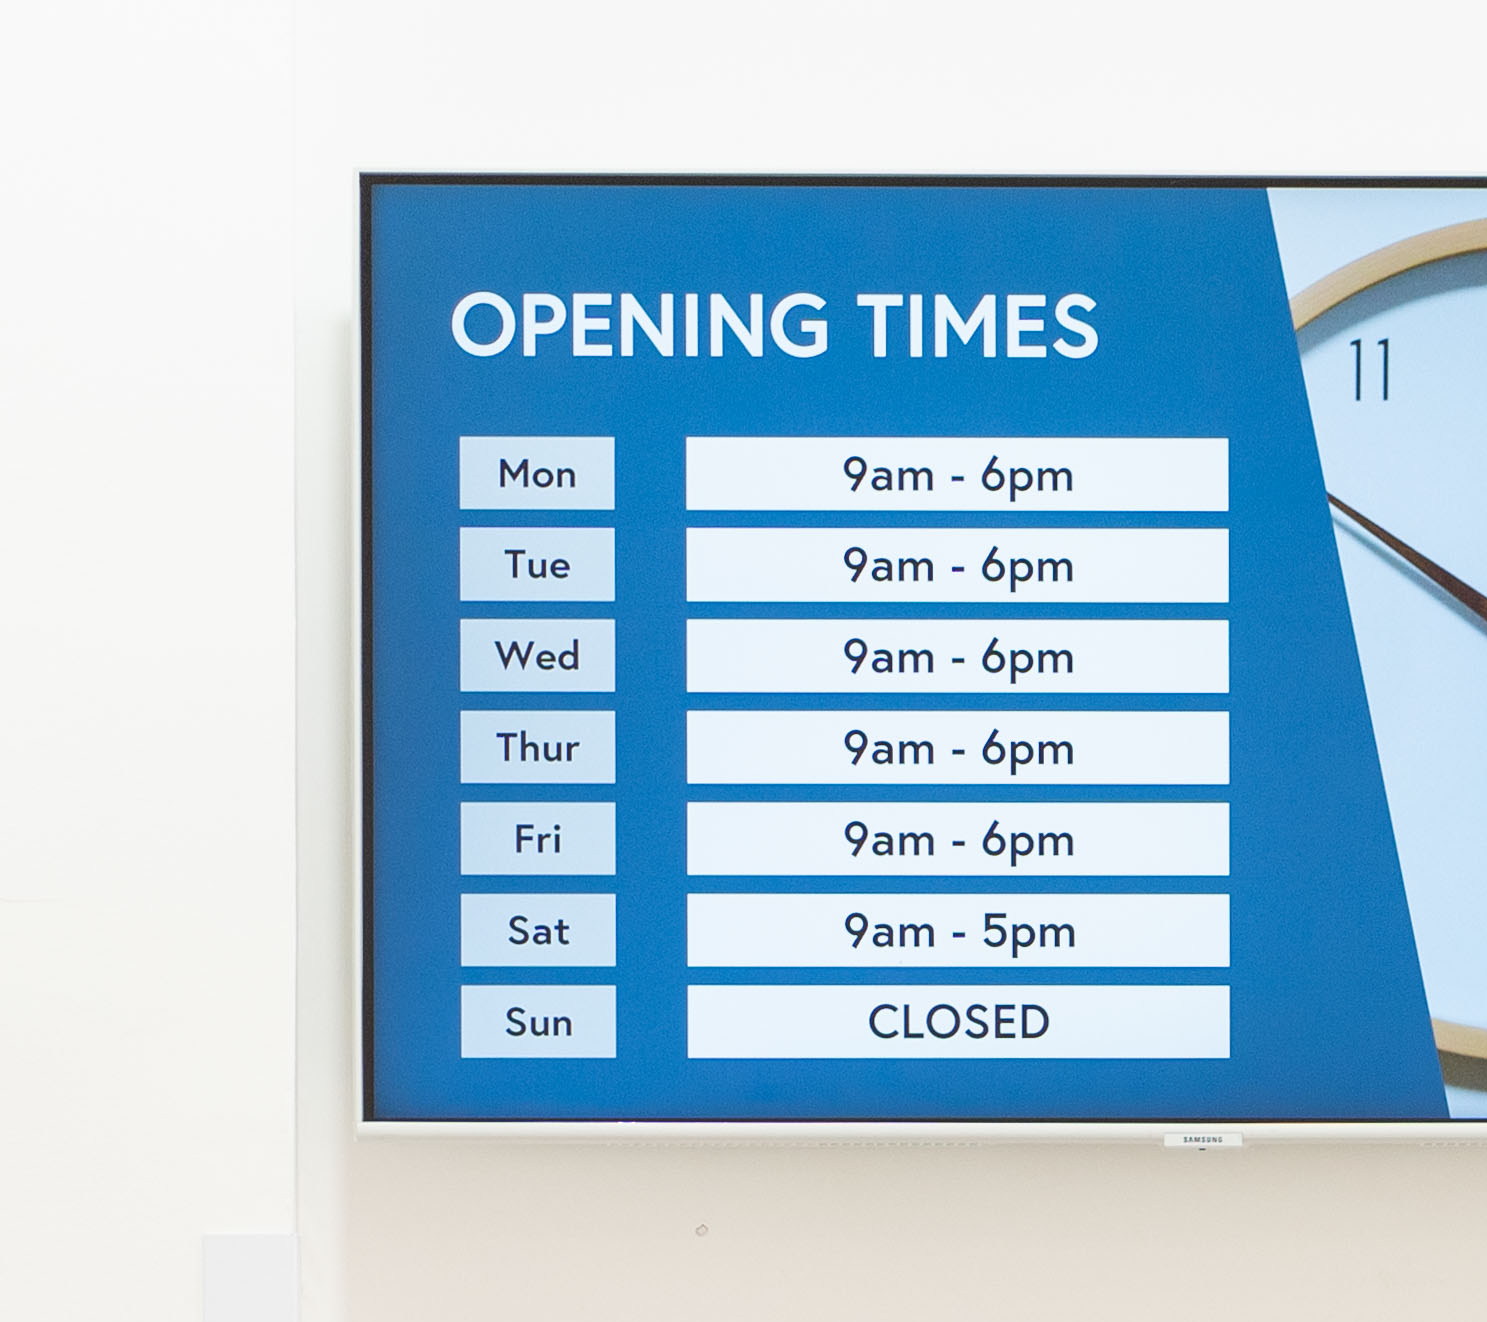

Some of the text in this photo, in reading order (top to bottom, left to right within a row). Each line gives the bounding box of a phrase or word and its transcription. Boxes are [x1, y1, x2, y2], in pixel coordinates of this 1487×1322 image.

[452, 292, 1098, 358] OPENING TIMES
[1350, 339, 1388, 401] 11
[500, 459, 575, 487] Mon
[844, 456, 933, 492] 9am
[982, 455, 1072, 502] 6pm
[505, 550, 570, 578] Tue
[844, 547, 933, 582] 9am
[982, 546, 1072, 592] 6pm
[495, 639, 578, 670] Wed
[844, 638, 933, 674] 9am
[982, 637, 1072, 684] 6pm
[496, 730, 580, 761] Thur
[845, 730, 933, 765] 9am
[983, 729, 1073, 775] 6pm
[516, 824, 560, 853] Fri
[845, 821, 934, 857] 9am
[983, 820, 1073, 867] 6pm
[509, 916, 569, 945] Sat
[845, 913, 934, 948] 9am
[984, 913, 1074, 958] 5pm
[506, 1007, 571, 1036] Sun
[869, 1004, 1049, 1039] CLOSED
